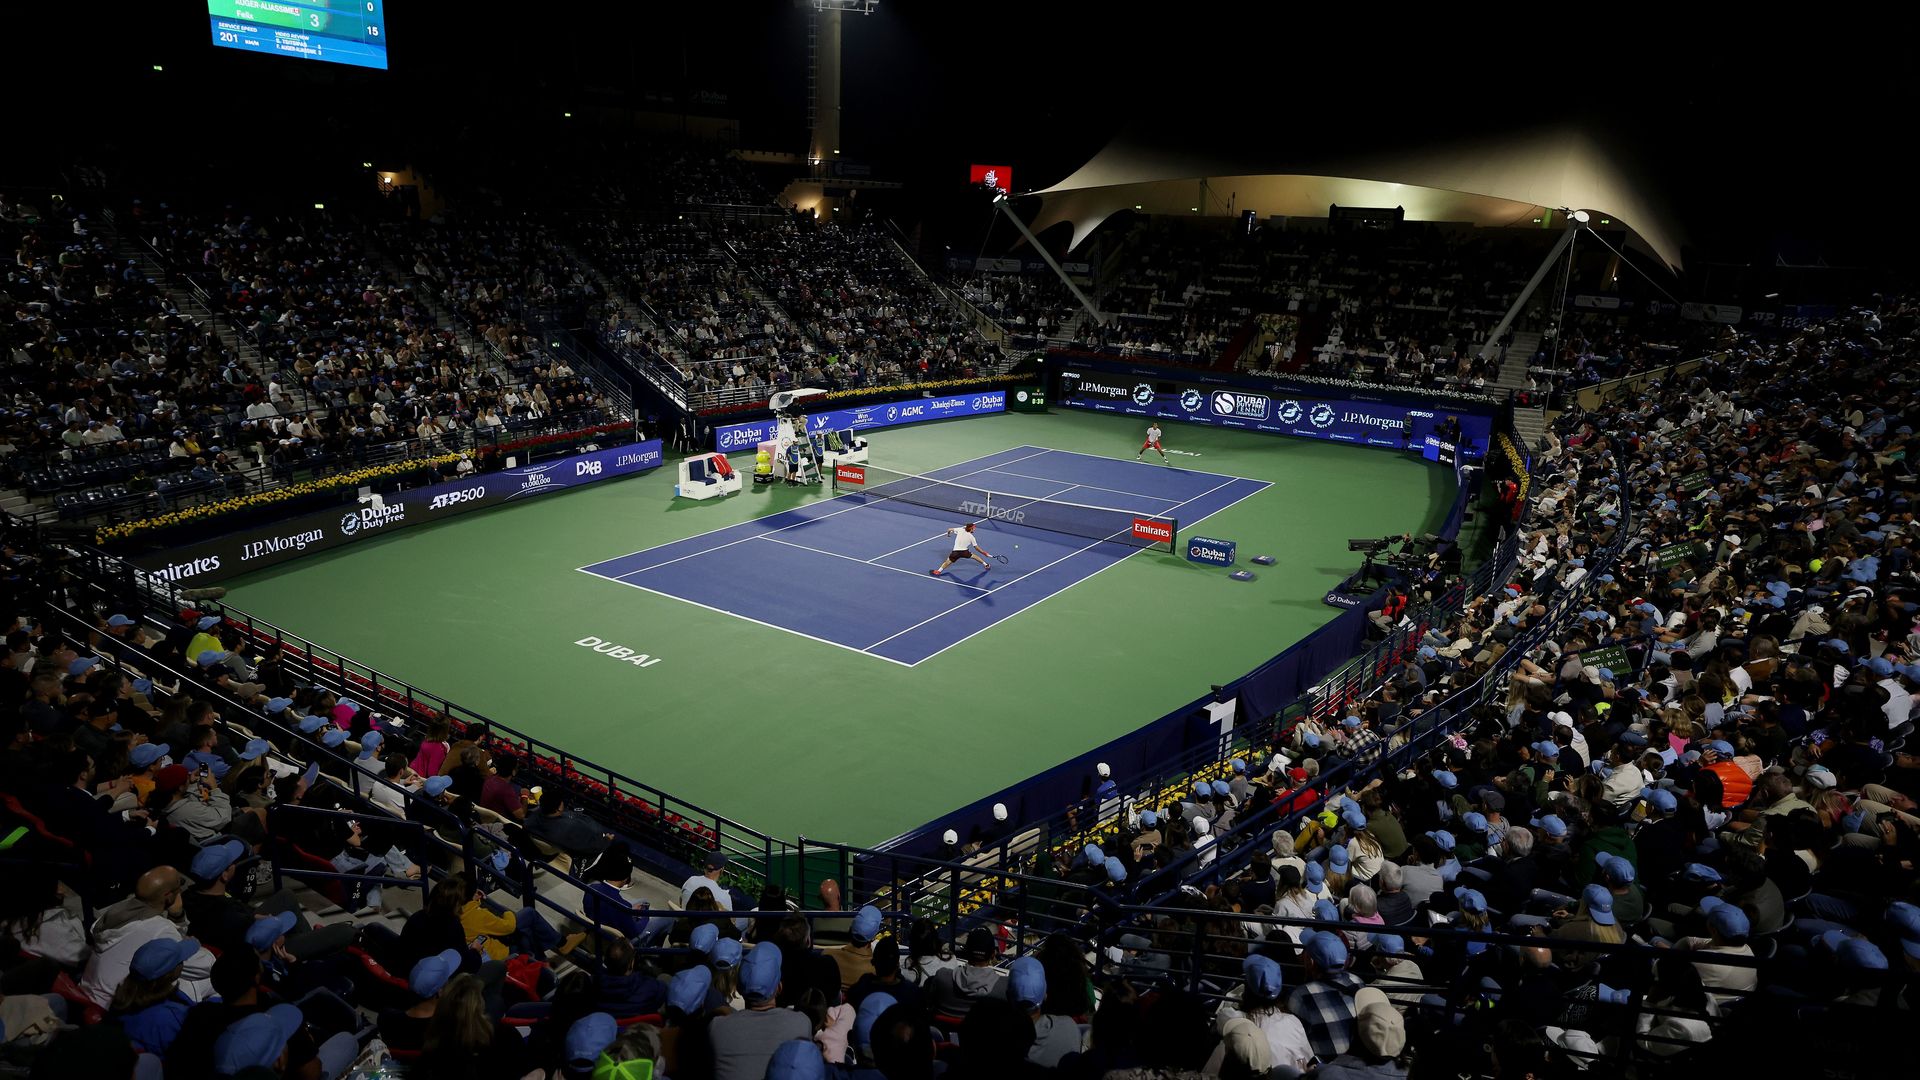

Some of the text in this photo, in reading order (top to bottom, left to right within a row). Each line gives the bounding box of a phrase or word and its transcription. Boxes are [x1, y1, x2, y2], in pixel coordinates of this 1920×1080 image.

[367, 2, 373, 11] 0
[237, 9, 254, 20] Felix
[310, 14, 319, 27] 3
[220, 31, 238, 43] 201
[367, 26, 378, 36] 15
[1078, 381, 1127, 397] J.P.Morgan
[982, 395, 1003, 404] Dubai
[1236, 395, 1266, 405] DUBAI
[901, 405, 924, 417] AGMC
[1236, 406, 1265, 414] TENNIS
[1341, 412, 1404, 431] J.P.Morgan
[734, 428, 762, 440] Dubai
[734, 434, 762, 446] Duty Free
[615, 449, 659, 468] J.P.Morgan
[528, 473, 544, 482] Win
[837, 470, 864, 480] Emirates
[361, 502, 404, 521] Dubai
[958, 500, 987, 515] ATP
[362, 518, 383, 530] Duty
[385, 512, 405, 524] Free
[1134, 522, 1170, 538] Emirates
[241, 528, 323, 561] J.P.Morgan
[1201, 547, 1226, 558] Dubai
[574, 636, 661, 668] DUBAI
[1582, 655, 1601, 664] ROWS
